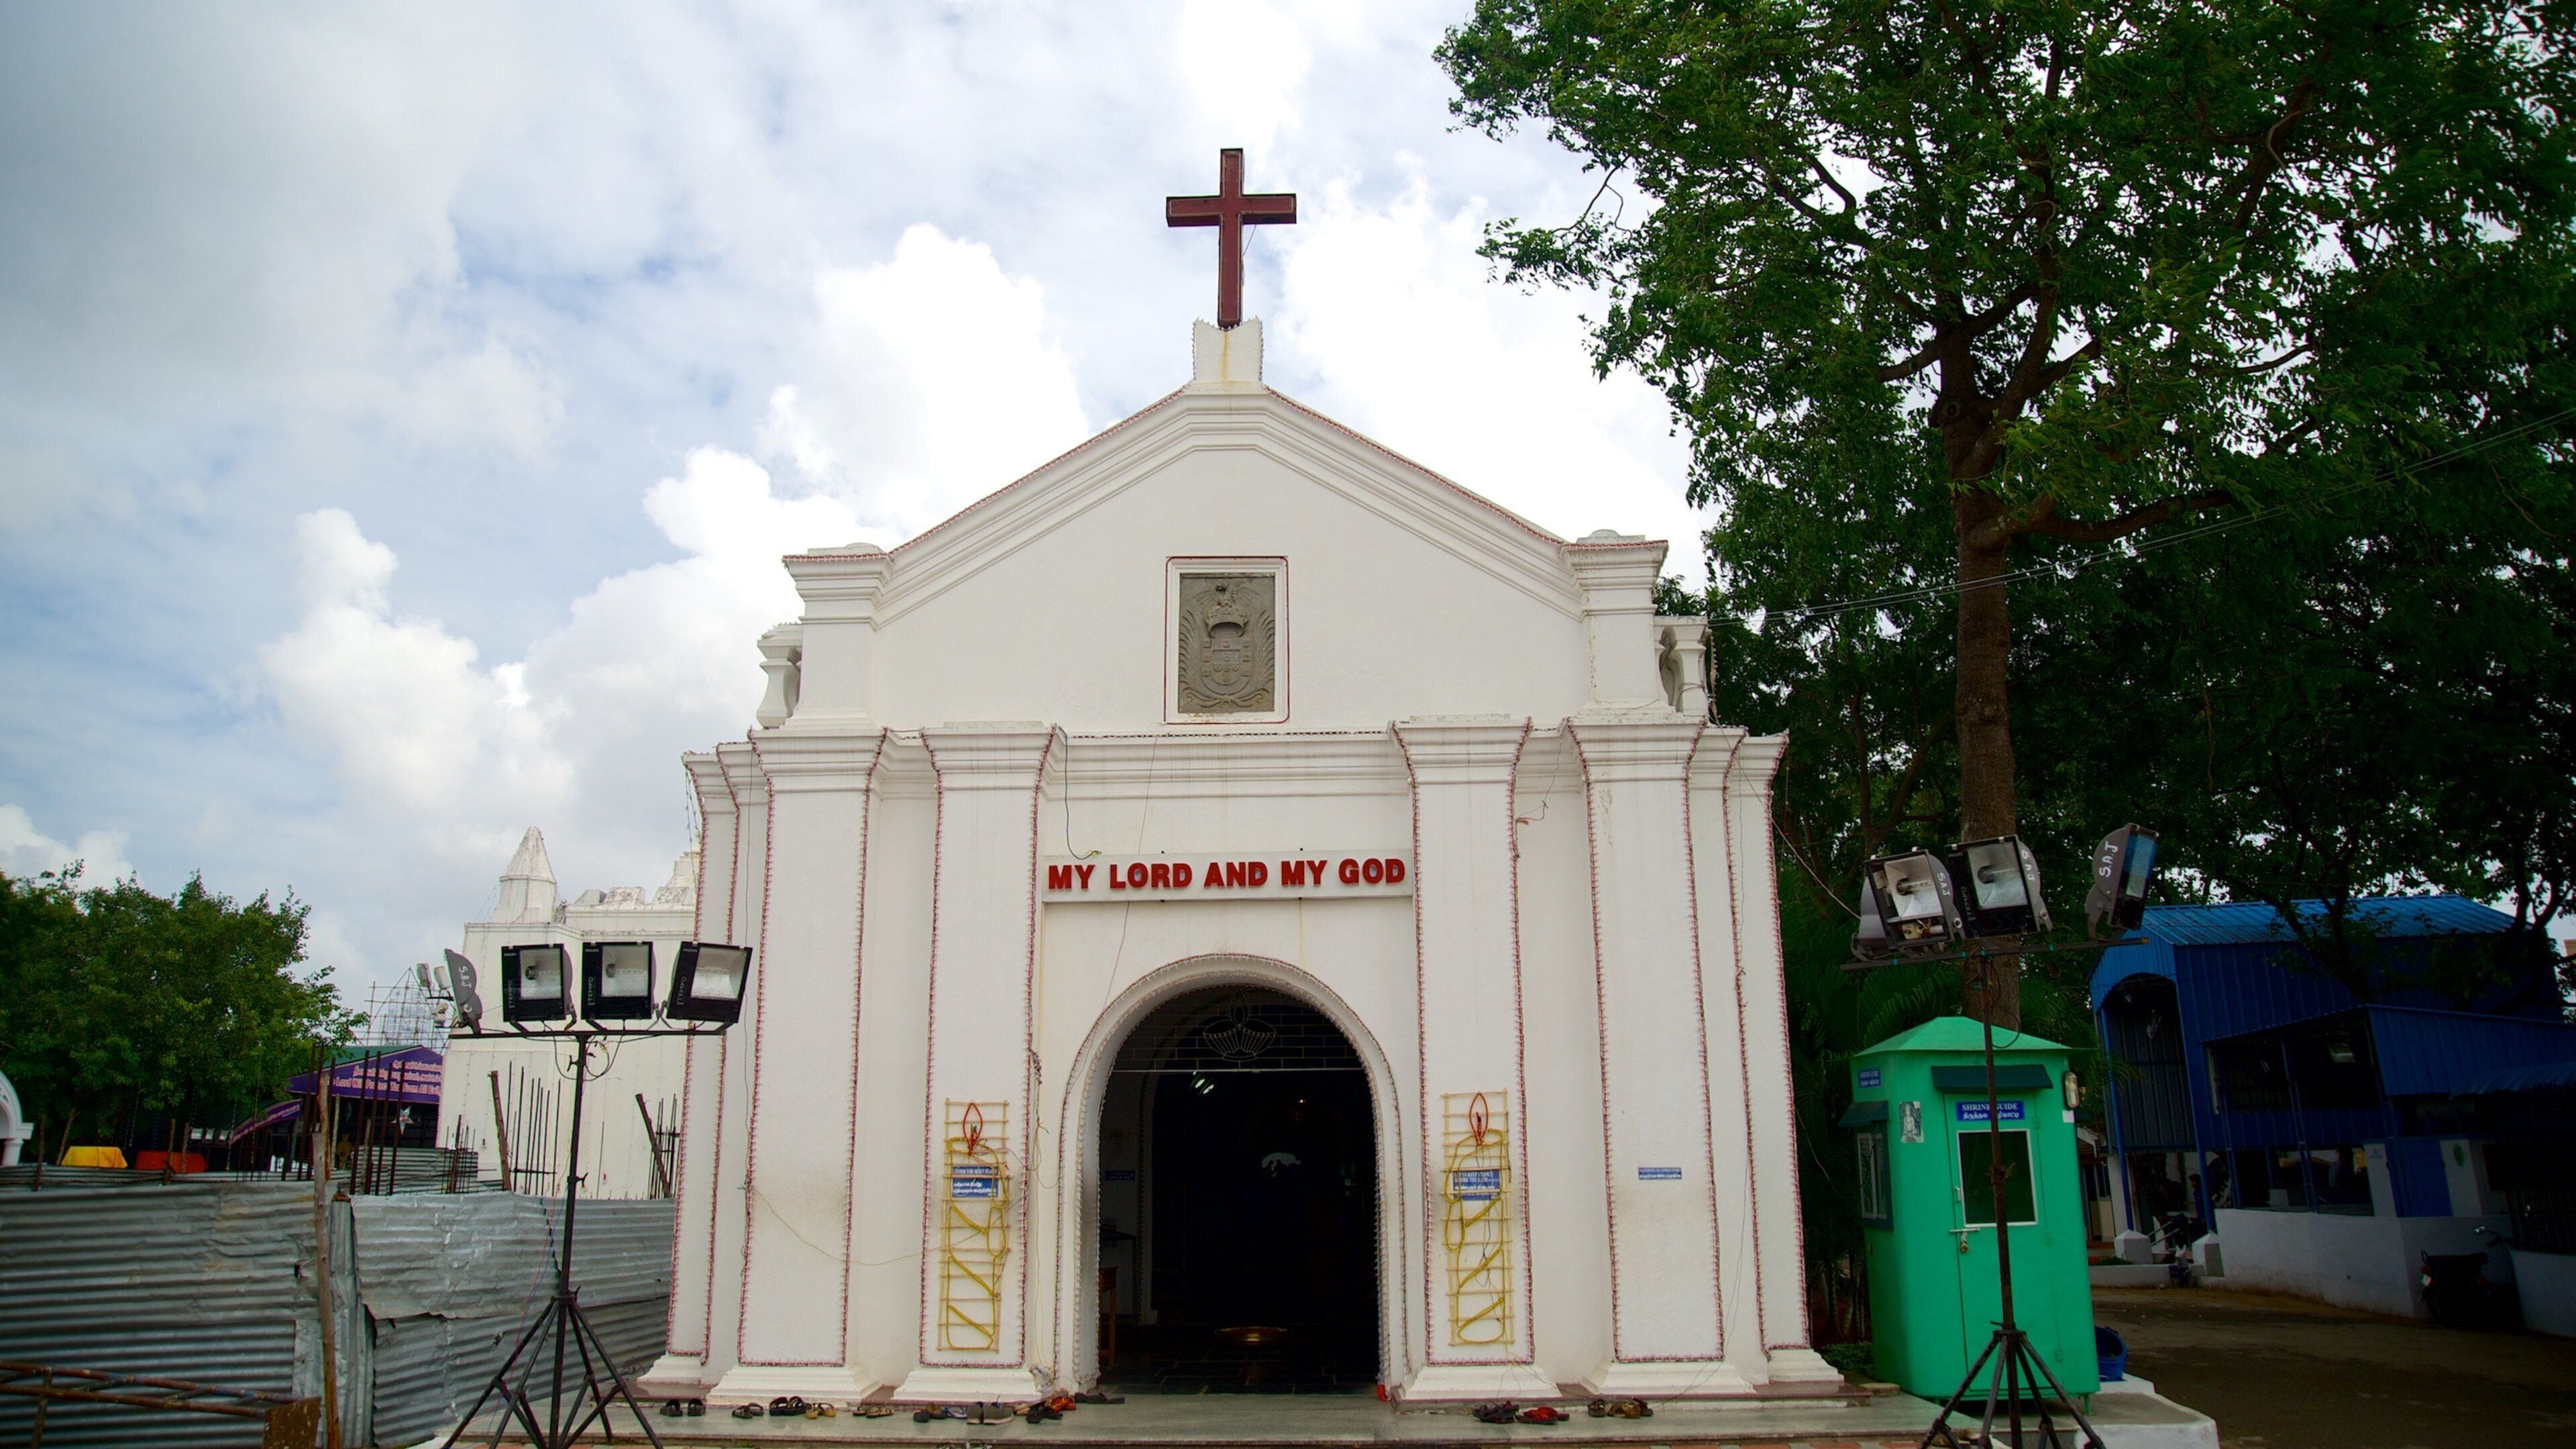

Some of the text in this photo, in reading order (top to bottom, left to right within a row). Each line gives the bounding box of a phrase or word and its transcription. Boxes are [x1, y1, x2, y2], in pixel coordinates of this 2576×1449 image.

[1048, 859, 1405, 890] MY LORD AND MY GOD
